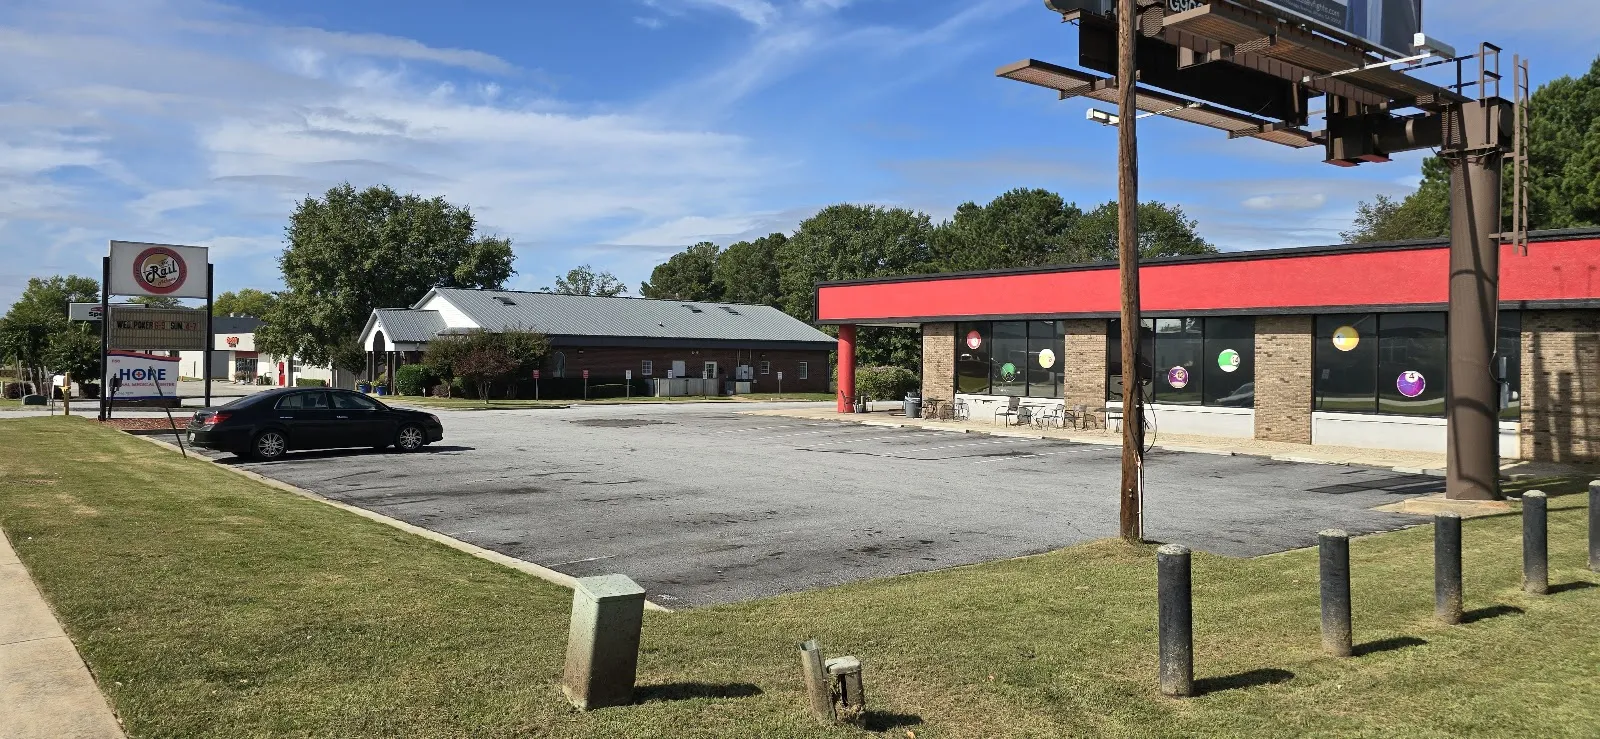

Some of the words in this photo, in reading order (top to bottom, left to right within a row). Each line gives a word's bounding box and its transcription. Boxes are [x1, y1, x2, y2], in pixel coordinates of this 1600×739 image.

[145, 259, 178, 284] Rail
[133, 320, 154, 330] POKER
[119, 368, 167, 381] HOPE
